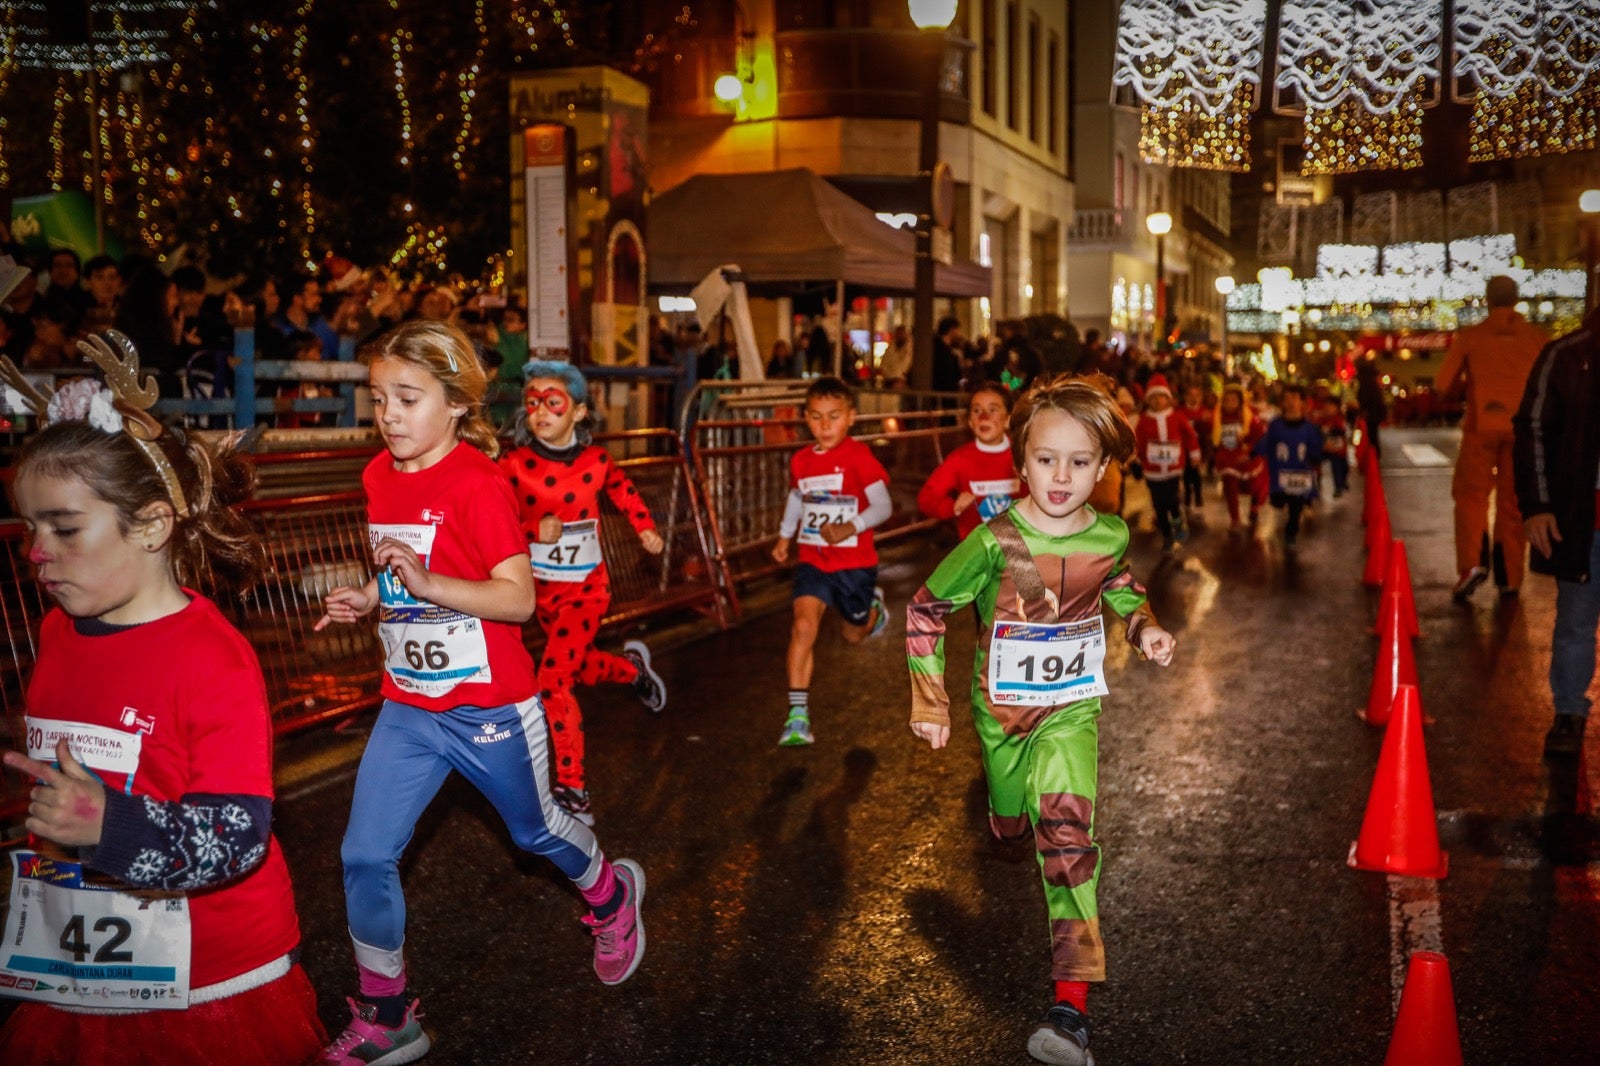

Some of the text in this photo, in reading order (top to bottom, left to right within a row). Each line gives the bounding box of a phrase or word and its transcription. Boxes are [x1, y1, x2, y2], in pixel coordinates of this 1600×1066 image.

[370, 530, 379, 545] 30
[548, 545, 580, 564] 47
[404, 640, 449, 670] 66
[1018, 651, 1085, 682] 194
[28, 726, 42, 750] 30
[76, 734, 122, 749] NOCTURNA
[474, 730, 511, 743] KELME
[60, 915, 133, 962] 42
